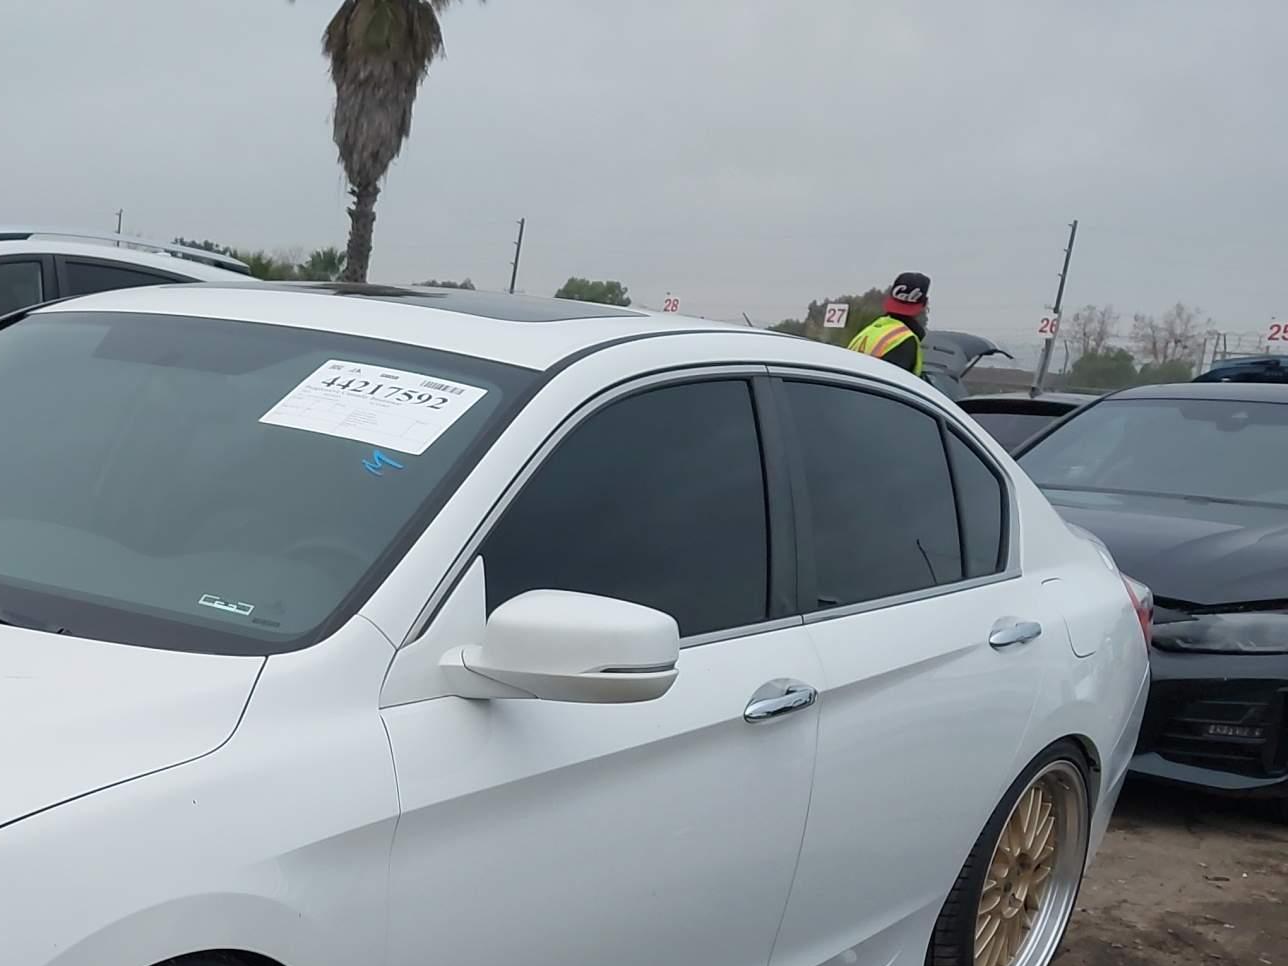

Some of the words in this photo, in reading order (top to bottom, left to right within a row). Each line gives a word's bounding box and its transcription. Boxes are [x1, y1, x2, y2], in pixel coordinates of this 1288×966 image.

[663, 298, 679, 312] 28
[826, 308, 846, 324] 27
[1038, 317, 1058, 334] 26
[321, 375, 449, 410] 44217592
